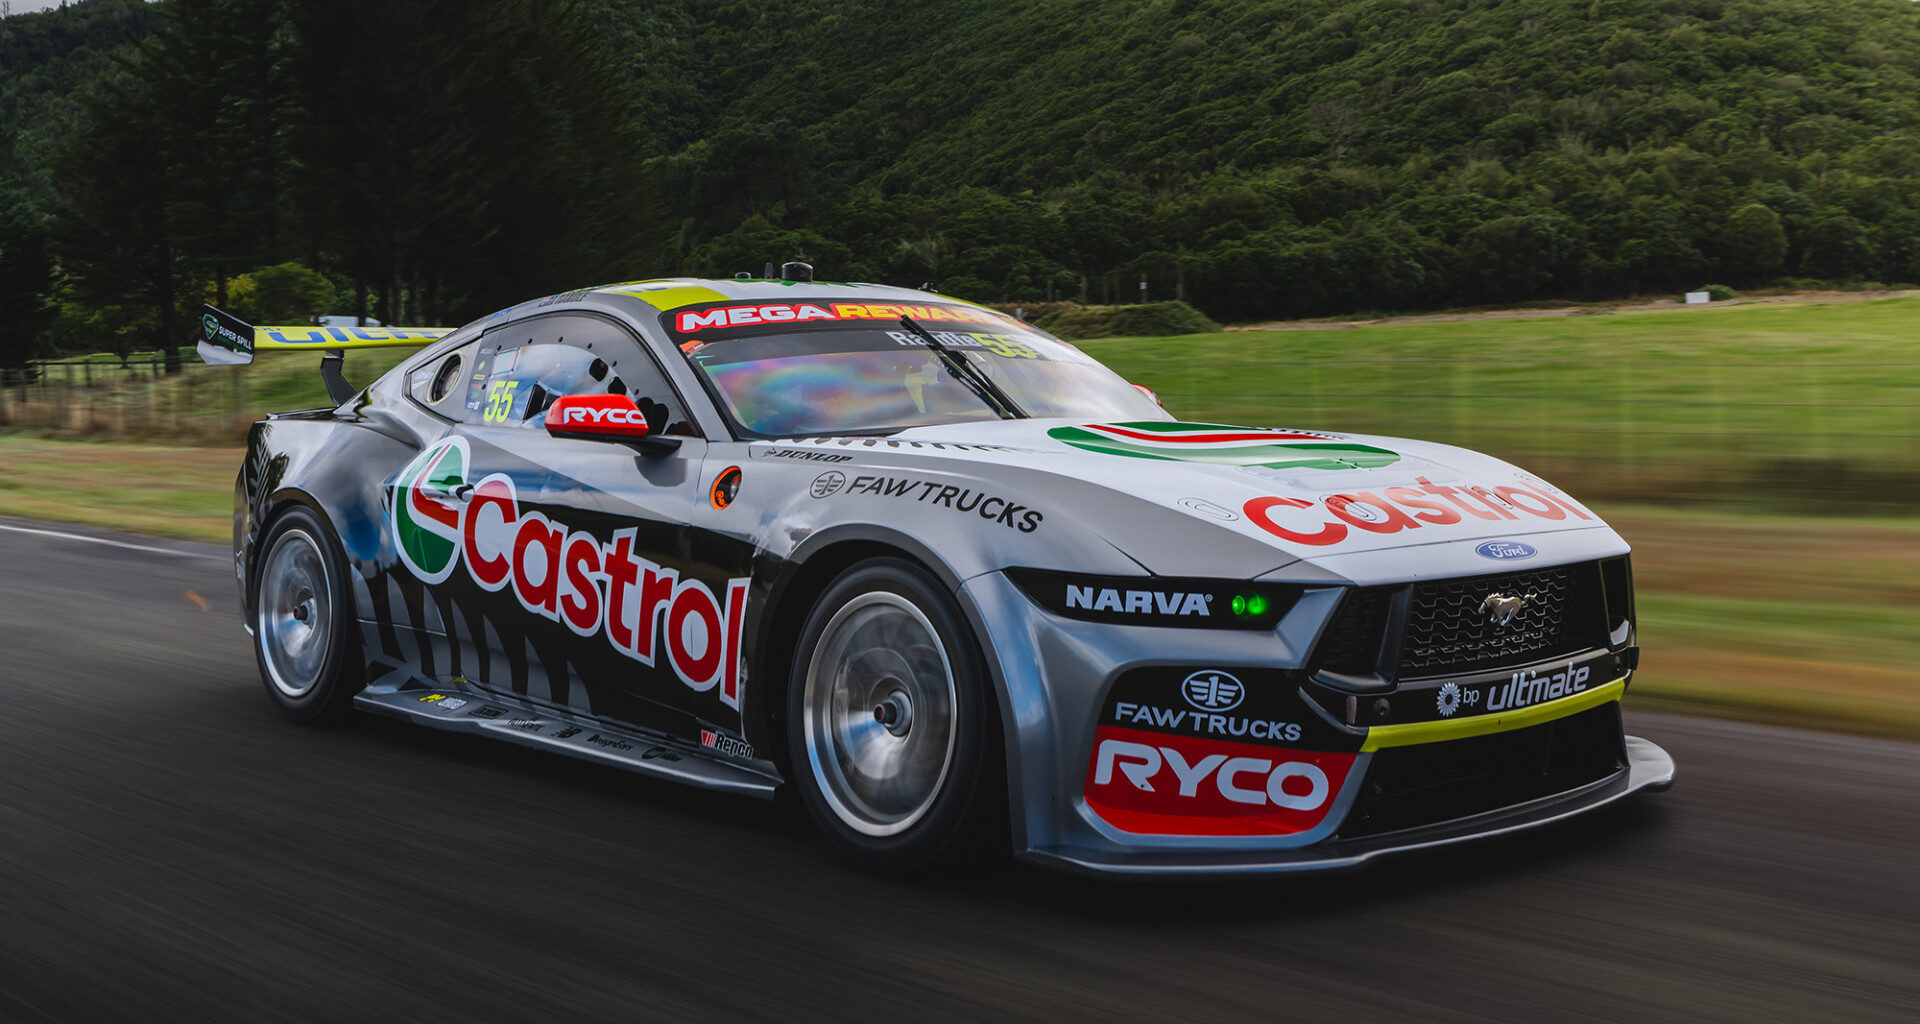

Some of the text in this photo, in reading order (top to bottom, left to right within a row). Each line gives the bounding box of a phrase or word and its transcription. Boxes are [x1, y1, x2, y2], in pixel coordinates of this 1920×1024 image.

[218, 326, 237, 342] SUPER
[236, 335, 252, 350] SPILL
[683, 304, 1032, 331] MEGA REWAR
[969, 333, 1038, 359] 55
[484, 381, 519, 423] 55
[775, 449, 853, 463] DUNLOP
[848, 475, 1044, 533] FAW TRUCKS
[1242, 476, 1595, 547] Castrol
[1488, 542, 1528, 559] Ford
[463, 479, 747, 702] Castrol
[1463, 661, 1591, 712] bp ultimate
[1114, 701, 1302, 742] FAW TRUCKS
[714, 731, 754, 760] Repco
[1094, 738, 1330, 811] RYCO
